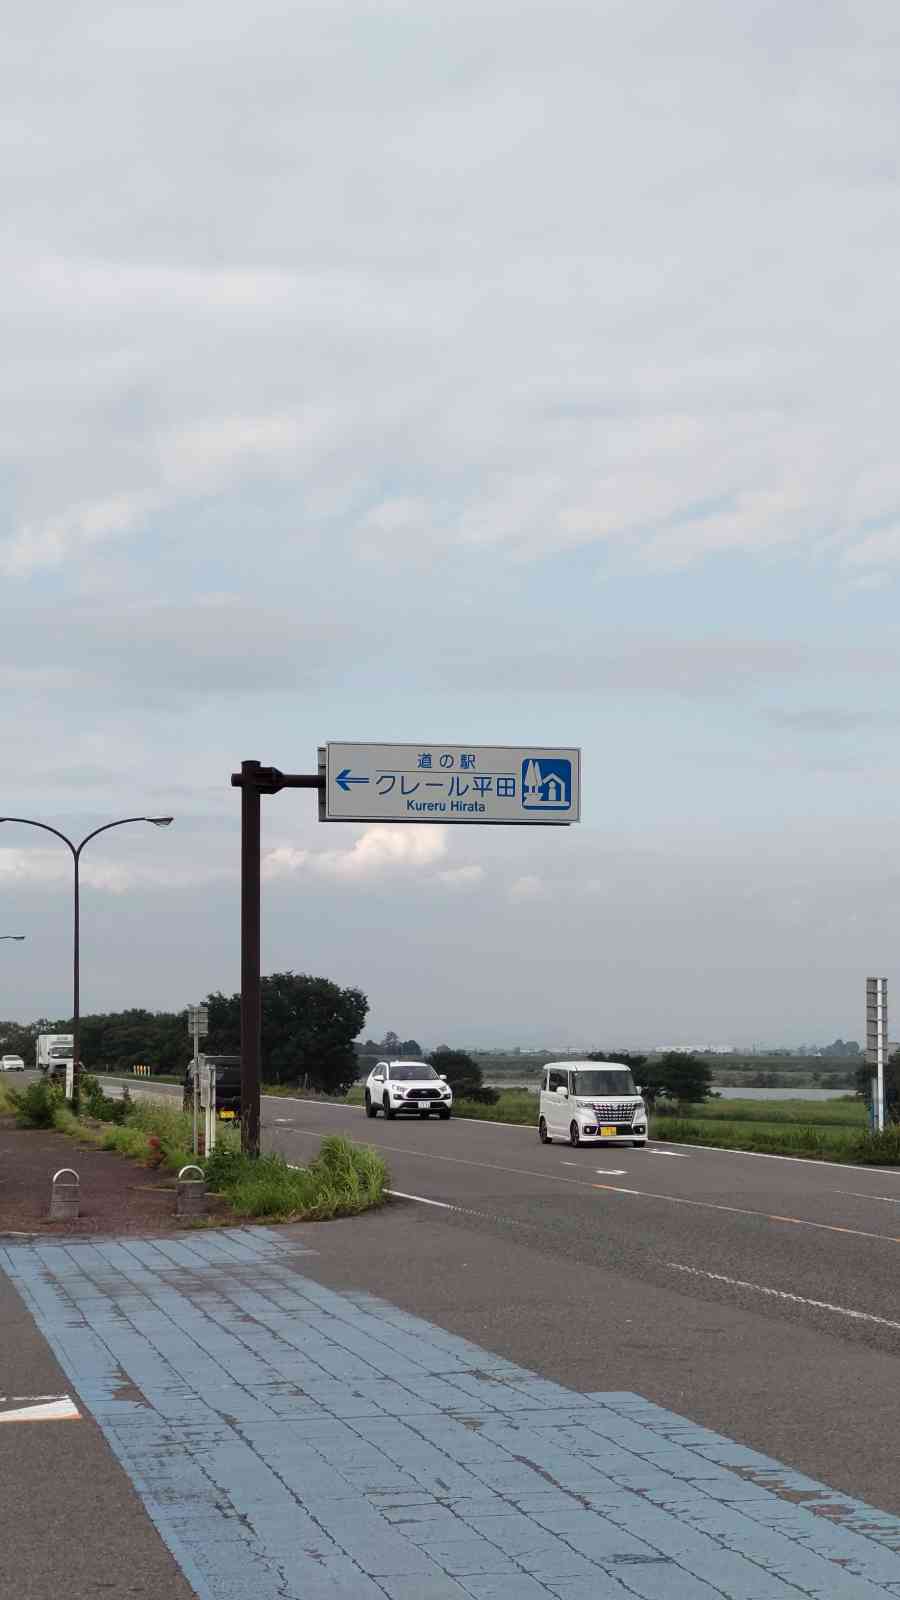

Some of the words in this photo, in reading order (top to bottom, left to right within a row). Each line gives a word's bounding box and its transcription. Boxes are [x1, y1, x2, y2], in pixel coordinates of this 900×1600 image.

[417, 753, 476, 769] 道の駅
[376, 775, 516, 798] クレール平田
[406, 800, 447, 812] Kureru
[450, 801, 486, 813] Hirata
